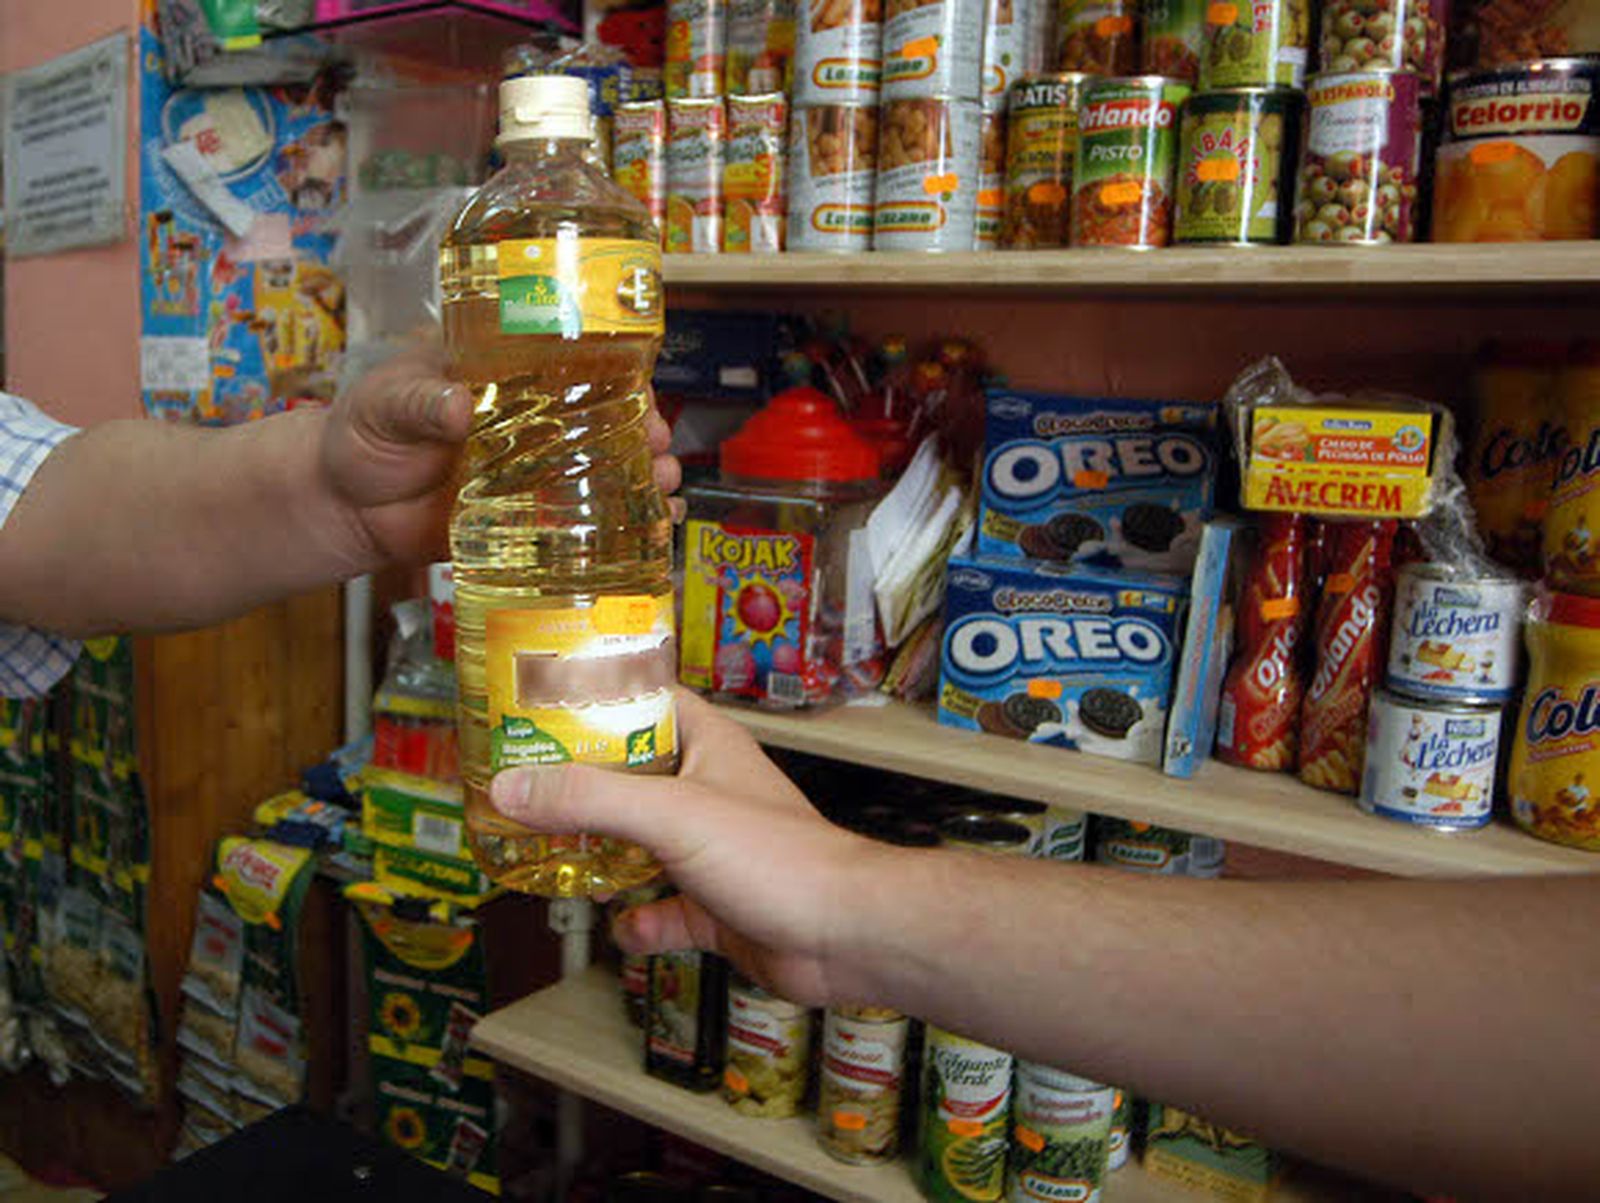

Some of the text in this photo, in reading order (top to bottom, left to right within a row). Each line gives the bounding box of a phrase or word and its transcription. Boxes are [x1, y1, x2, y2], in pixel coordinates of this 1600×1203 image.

[1079, 101, 1171, 128] Orlando
[1455, 96, 1581, 127] Celorrio
[1090, 145, 1143, 160] PISTO
[991, 438, 1204, 498] OREO
[1264, 476, 1403, 512] AVECREM
[702, 529, 795, 571] KOJAK
[1311, 585, 1380, 699] Orlando
[1411, 609, 1500, 638] Lechera
[951, 619, 1162, 673] OREO
[1526, 687, 1600, 744] Col
